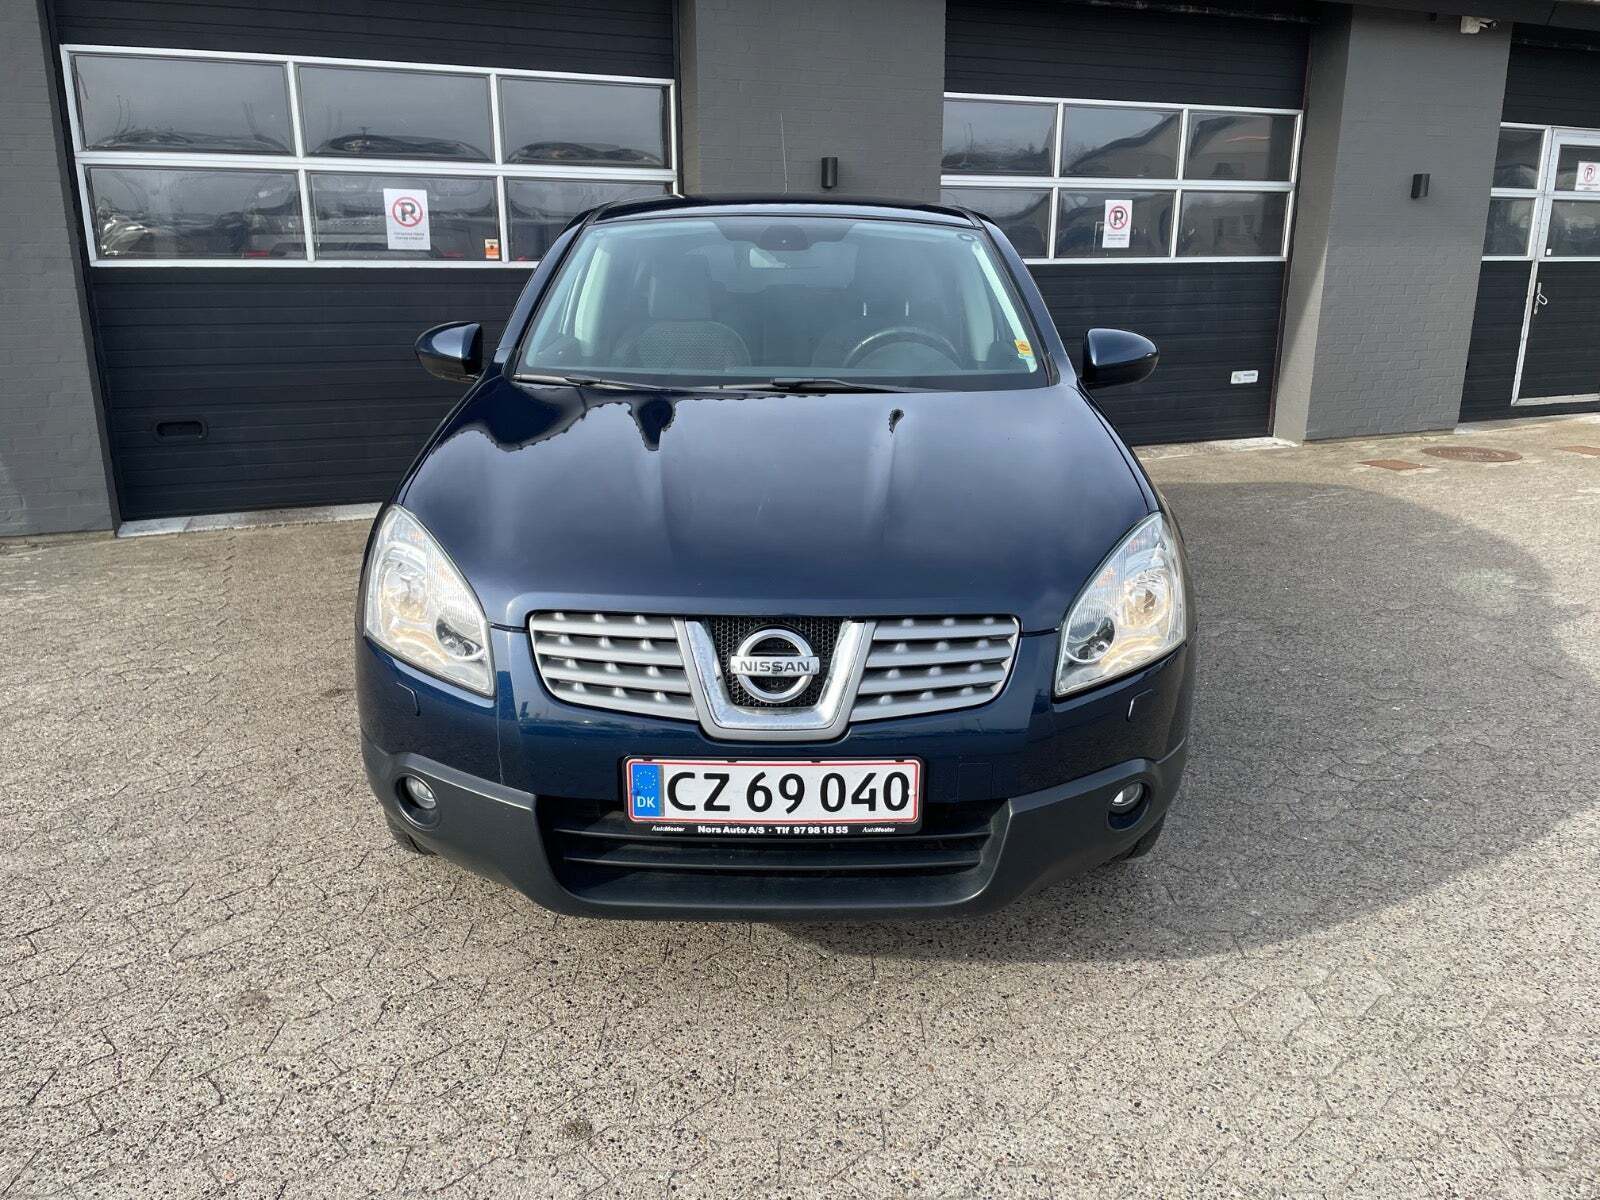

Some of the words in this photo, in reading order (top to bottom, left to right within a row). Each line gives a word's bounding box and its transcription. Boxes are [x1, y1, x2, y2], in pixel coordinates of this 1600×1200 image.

[740, 661, 810, 672] NISSAN
[667, 772, 731, 811] CZ
[746, 771, 805, 814] 69
[820, 771, 910, 812] 040
[636, 796, 656, 808] DK
[697, 825, 721, 833] Nors
[722, 825, 747, 833] Auto
[748, 825, 765, 834] A/S
[793, 826, 807, 834] 97
[807, 826, 820, 834] 98
[821, 826, 834, 834] 18
[835, 826, 849, 834] 55
